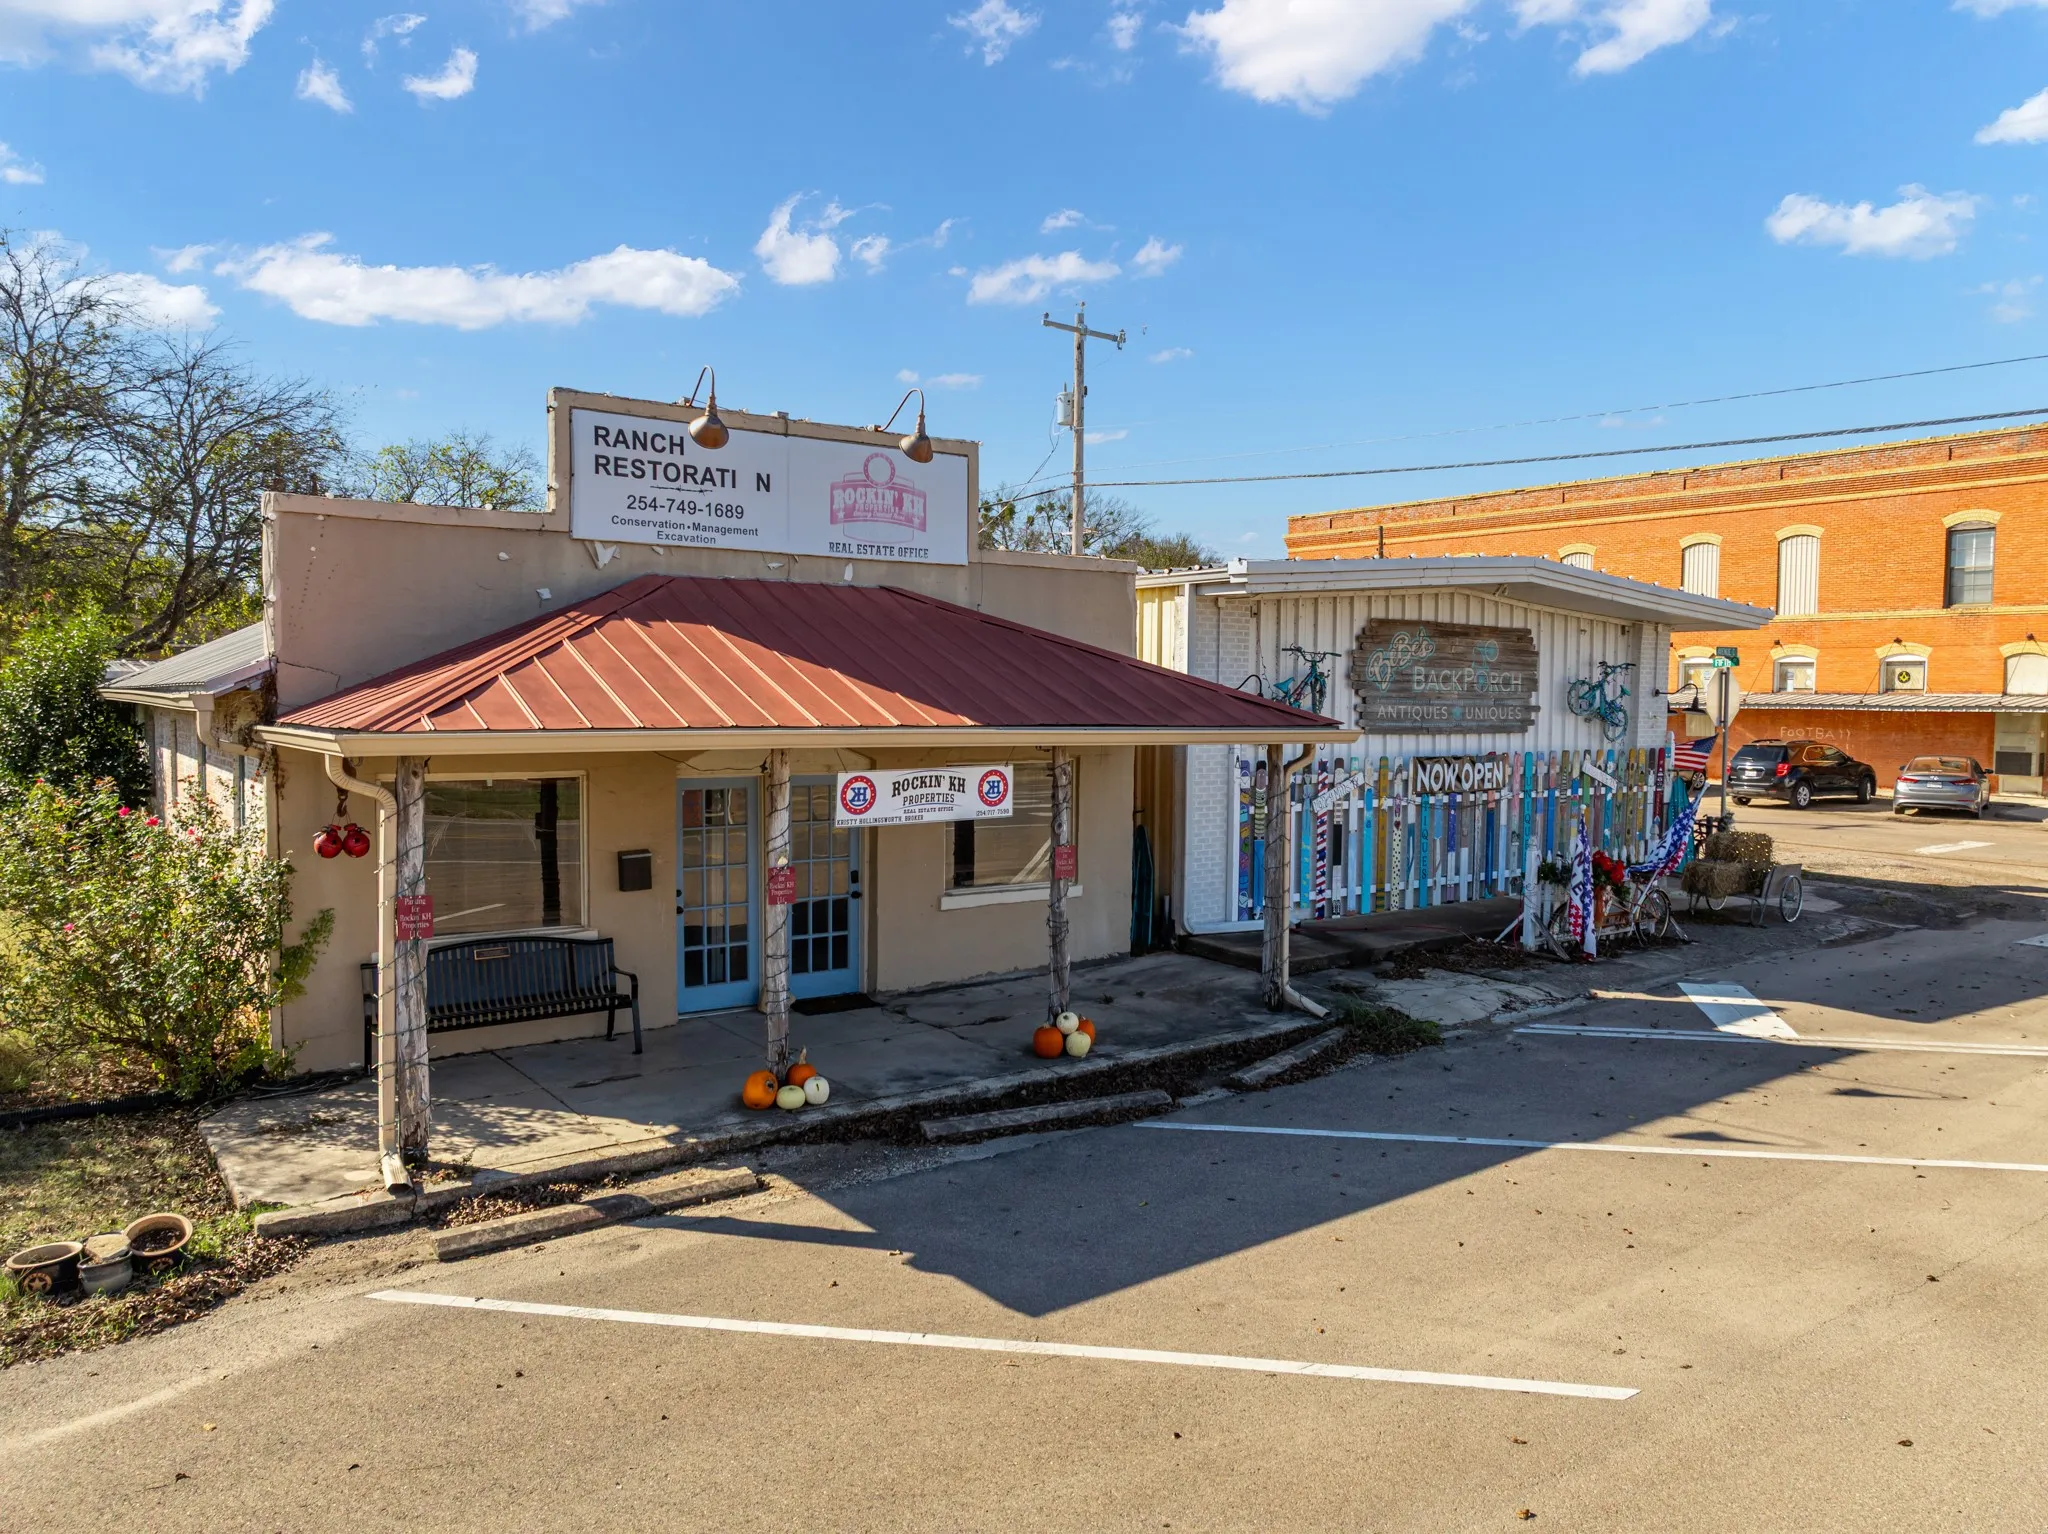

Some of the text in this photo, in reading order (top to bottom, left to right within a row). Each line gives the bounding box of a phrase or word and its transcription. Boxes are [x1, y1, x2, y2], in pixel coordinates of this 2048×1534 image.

[594, 425, 685, 455] RANCH
[627, 494, 744, 519] 254-749-1689
[833, 487, 898, 511] ROCKIN'
[902, 493, 924, 517] KH
[657, 530, 716, 544] Excavation
[829, 542, 929, 558] REAL ESTATE OFFICE
[1377, 705, 1521, 721] ANTIQUES UNIQUES
[1416, 761, 1503, 791] NOW OPEN
[891, 775, 966, 798] ROCKIN' KH
[903, 793, 955, 806] PROPERTIES
[837, 818, 858, 826] KRISTY
